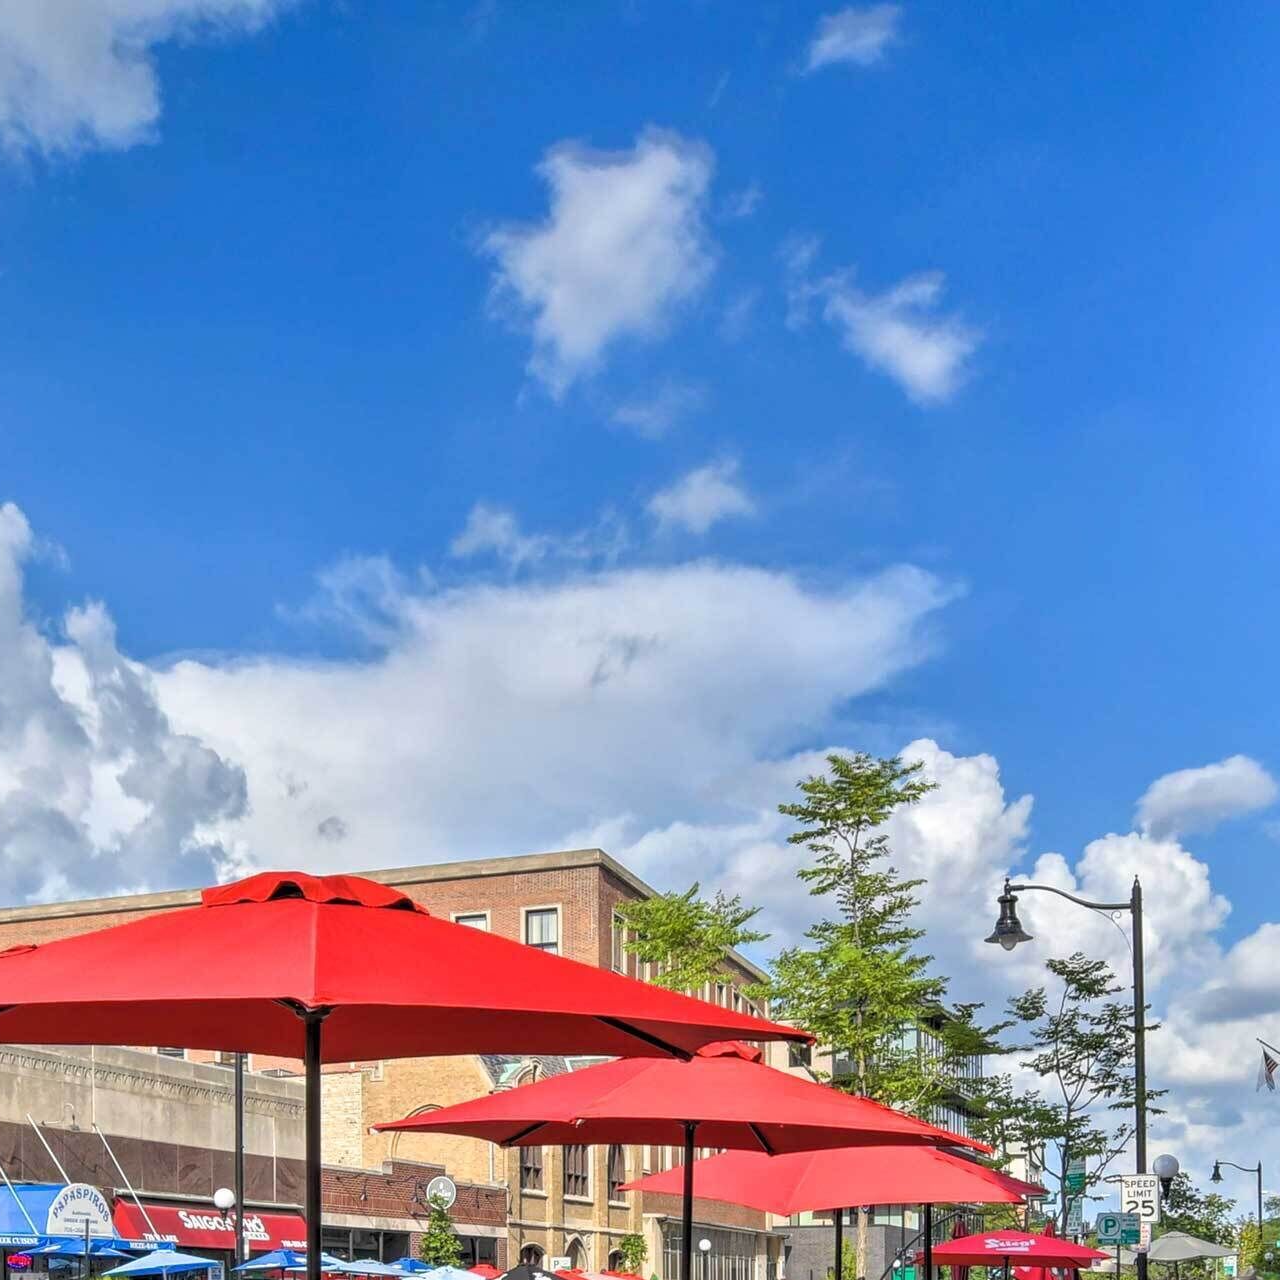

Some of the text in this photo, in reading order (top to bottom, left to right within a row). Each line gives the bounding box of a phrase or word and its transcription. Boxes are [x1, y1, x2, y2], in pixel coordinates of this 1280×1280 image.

[1124, 1180, 1156, 1188] SPEED
[1127, 1190, 1152, 1198] LIMIT
[1126, 1200, 1155, 1217] 25
[178, 1210, 234, 1232] SAIGON
[1104, 1219, 1116, 1233] P
[12, 1237, 39, 1245] CUISINE
